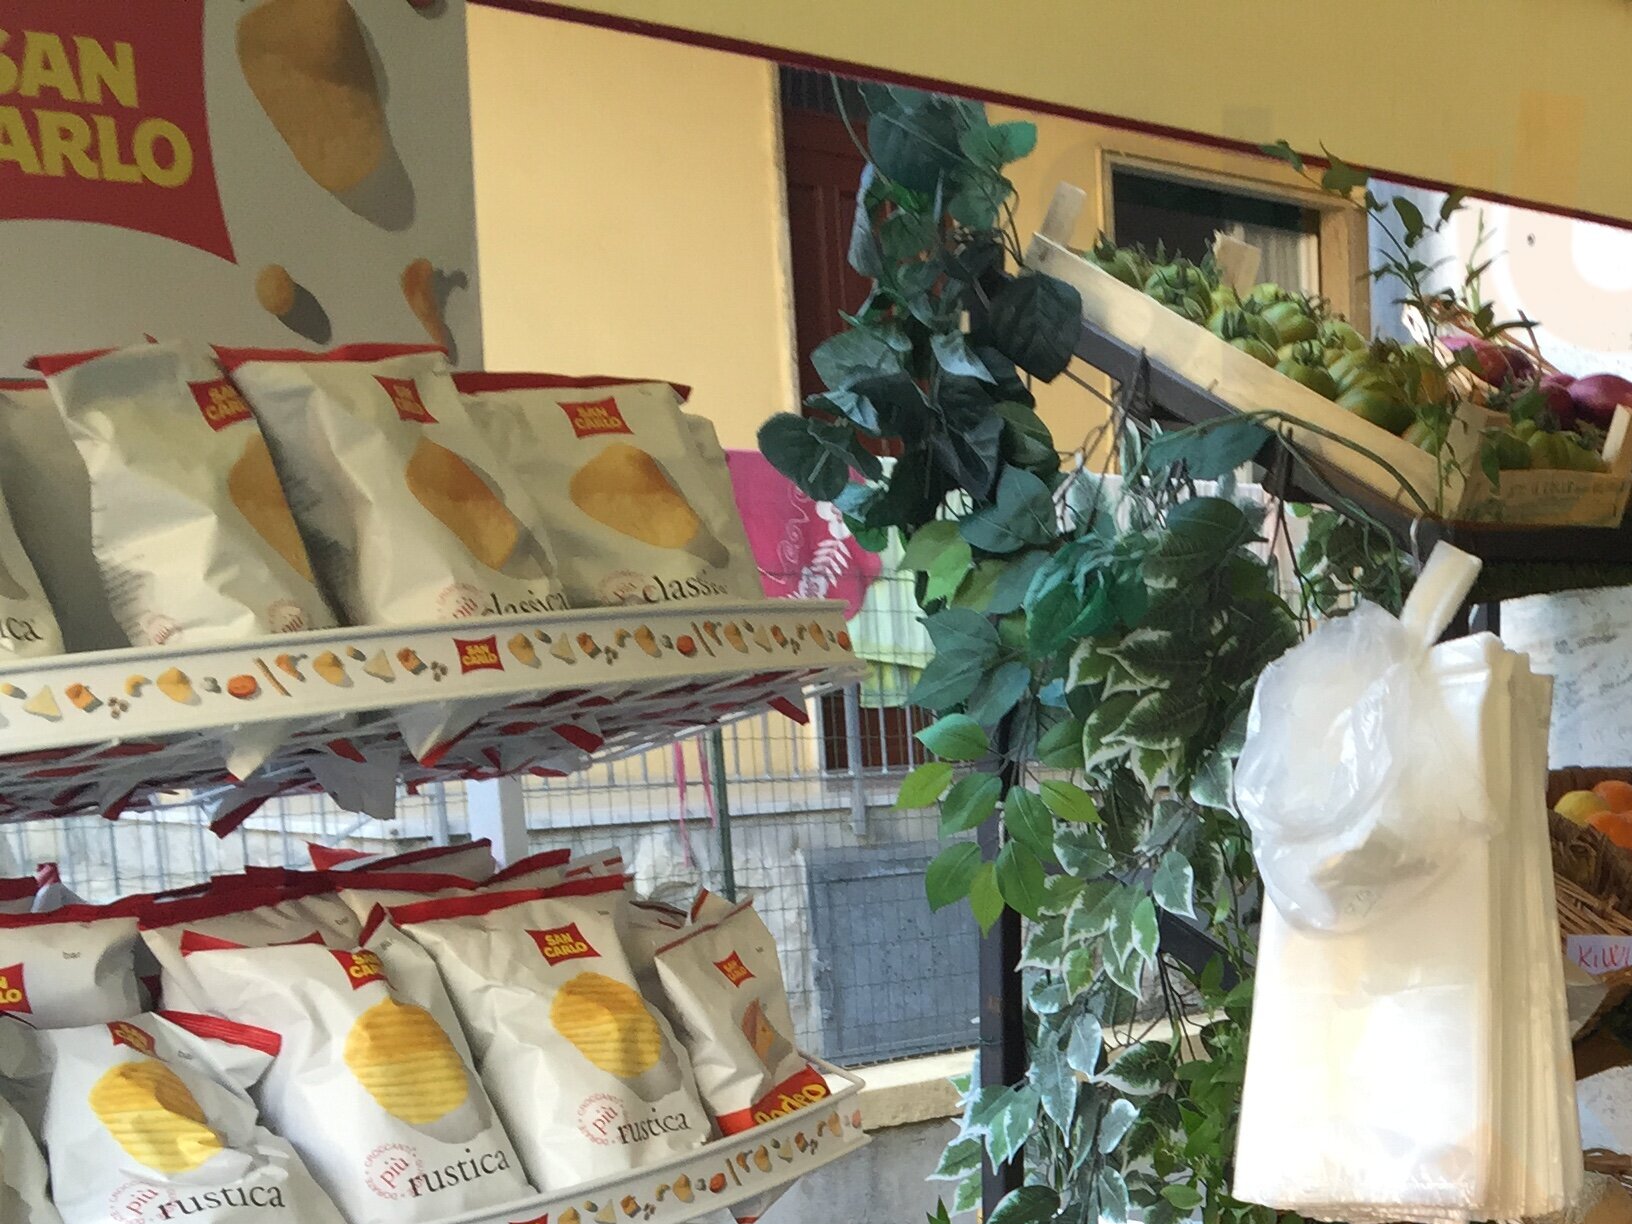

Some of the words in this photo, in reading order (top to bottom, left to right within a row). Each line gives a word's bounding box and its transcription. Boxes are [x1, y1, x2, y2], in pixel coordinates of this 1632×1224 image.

[0, 105, 194, 188] ARLO
[543, 942, 588, 958] CARLO
[544, 932, 574, 944] SAN
[592, 1102, 619, 1135] più
[617, 1106, 692, 1145] rustica
[379, 1156, 410, 1189] più
[408, 1147, 511, 1198] rustica
[126, 1187, 159, 1216] più
[157, 1184, 286, 1221] rustica
